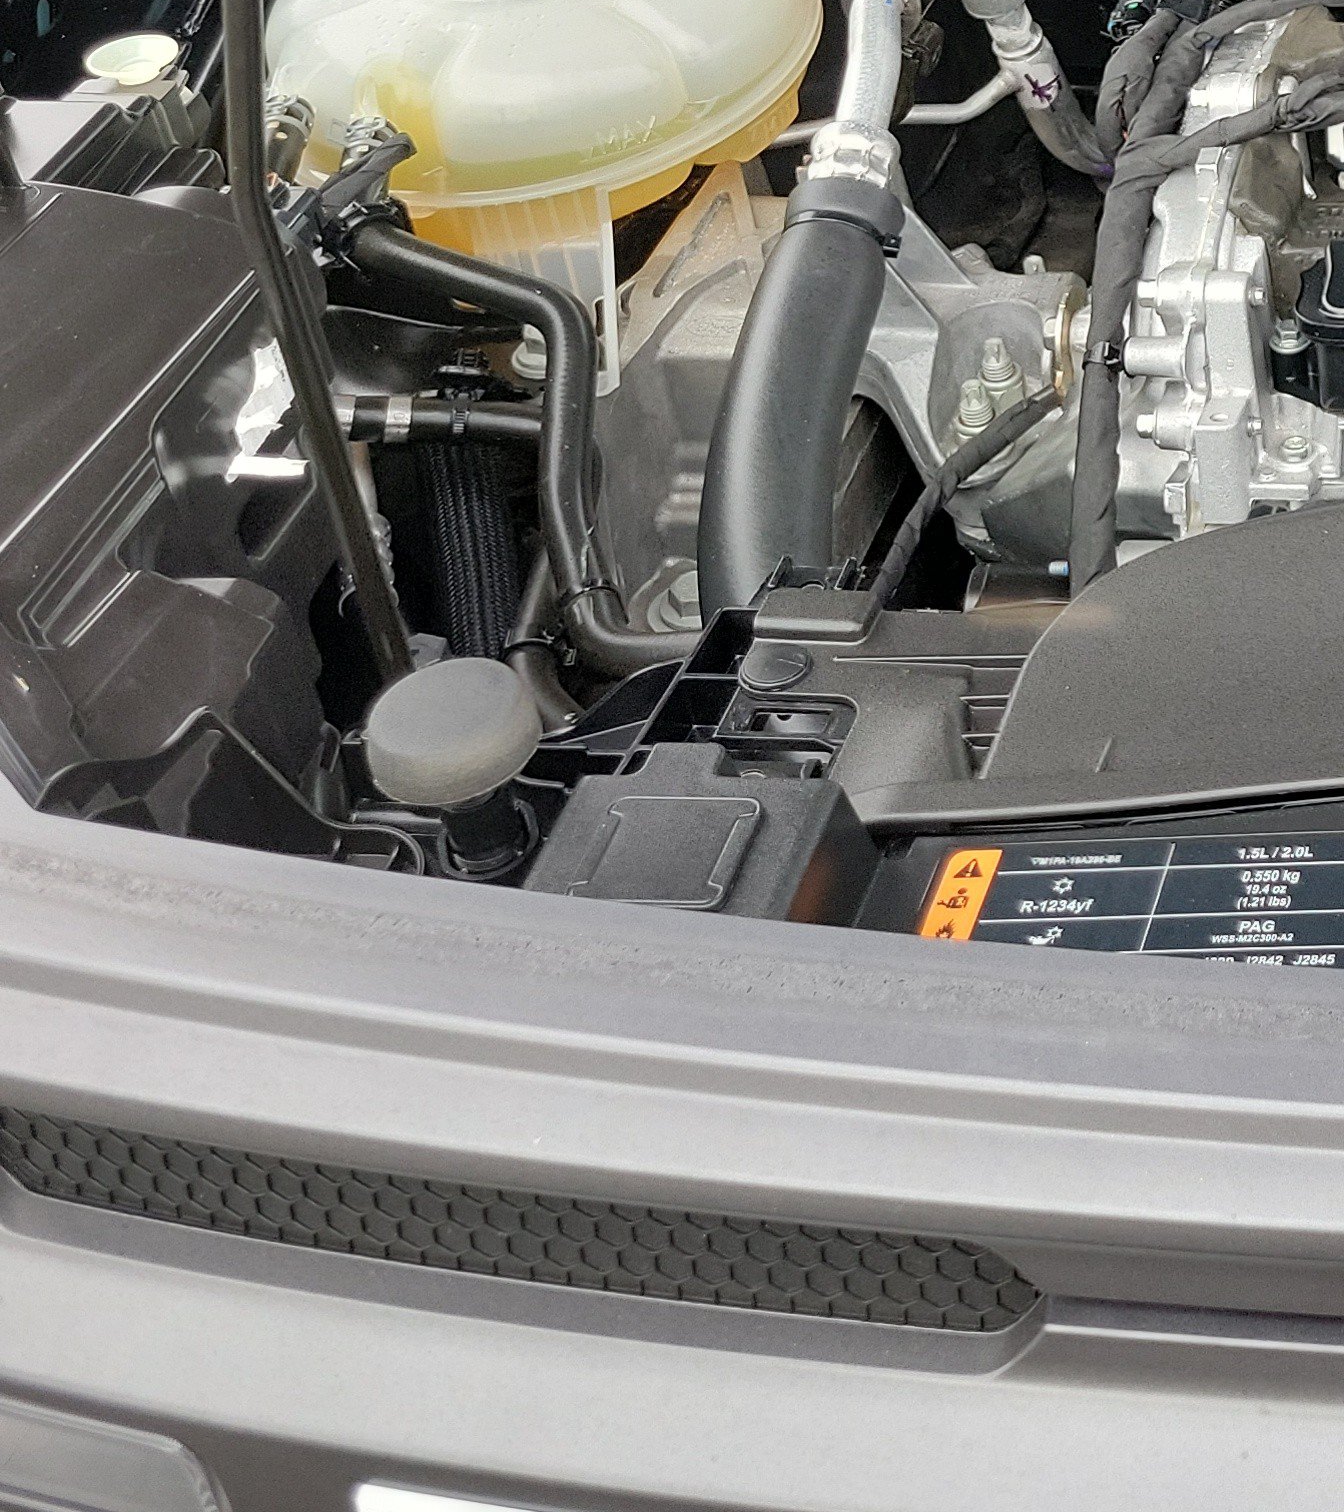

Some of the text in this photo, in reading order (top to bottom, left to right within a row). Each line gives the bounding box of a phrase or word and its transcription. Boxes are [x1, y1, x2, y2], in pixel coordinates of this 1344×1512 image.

[1237, 847, 1269, 860] 1.5L
[1281, 845, 1314, 859] 2.0L
[1241, 869, 1301, 884] 0.550 kg
[1245, 883, 1288, 895] 19.4 oz
[1020, 898, 1094, 914] R-1234yf
[1237, 895, 1292, 910] (1.21 lbs)
[1238, 920, 1276, 933] PAG
[1292, 954, 1336, 966] J2845
